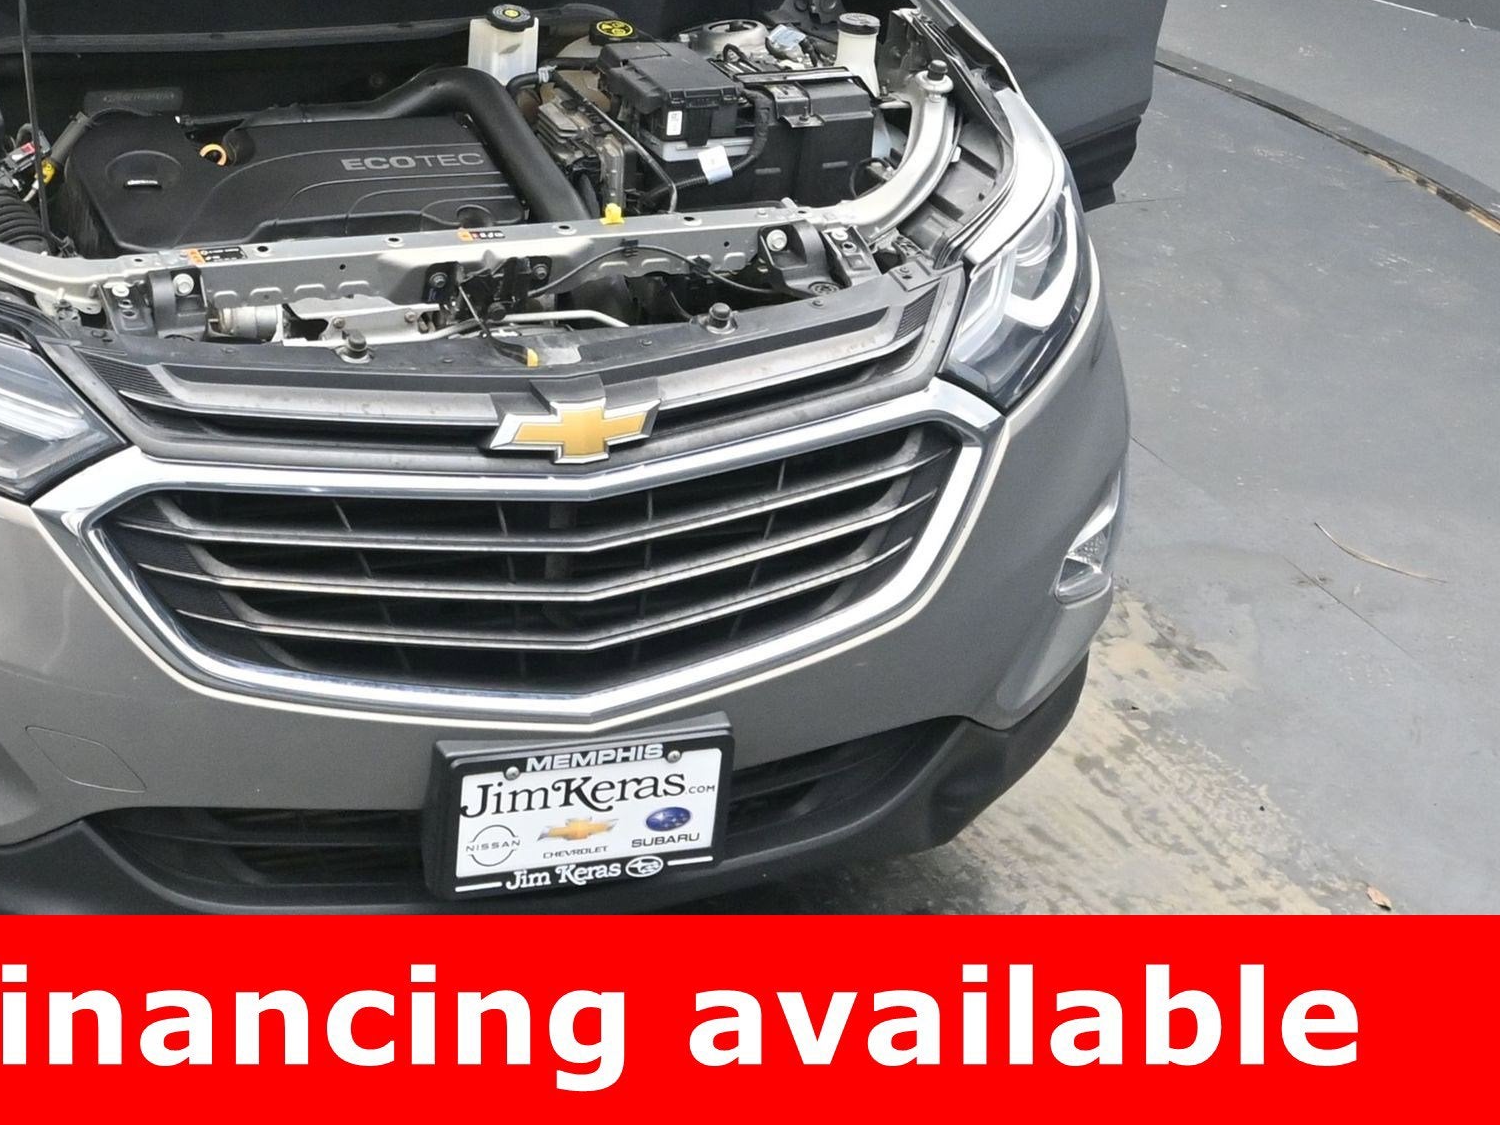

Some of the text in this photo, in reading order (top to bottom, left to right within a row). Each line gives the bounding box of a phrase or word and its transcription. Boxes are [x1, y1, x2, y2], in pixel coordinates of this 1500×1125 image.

[340, 152, 484, 171] ECOTEC
[526, 743, 664, 773] MEMPHIS
[465, 837, 522, 853] NISSAN
[631, 832, 701, 849] SUBARU
[542, 845, 608, 859] CHEVROLET
[505, 860, 622, 891] Jim Keras
